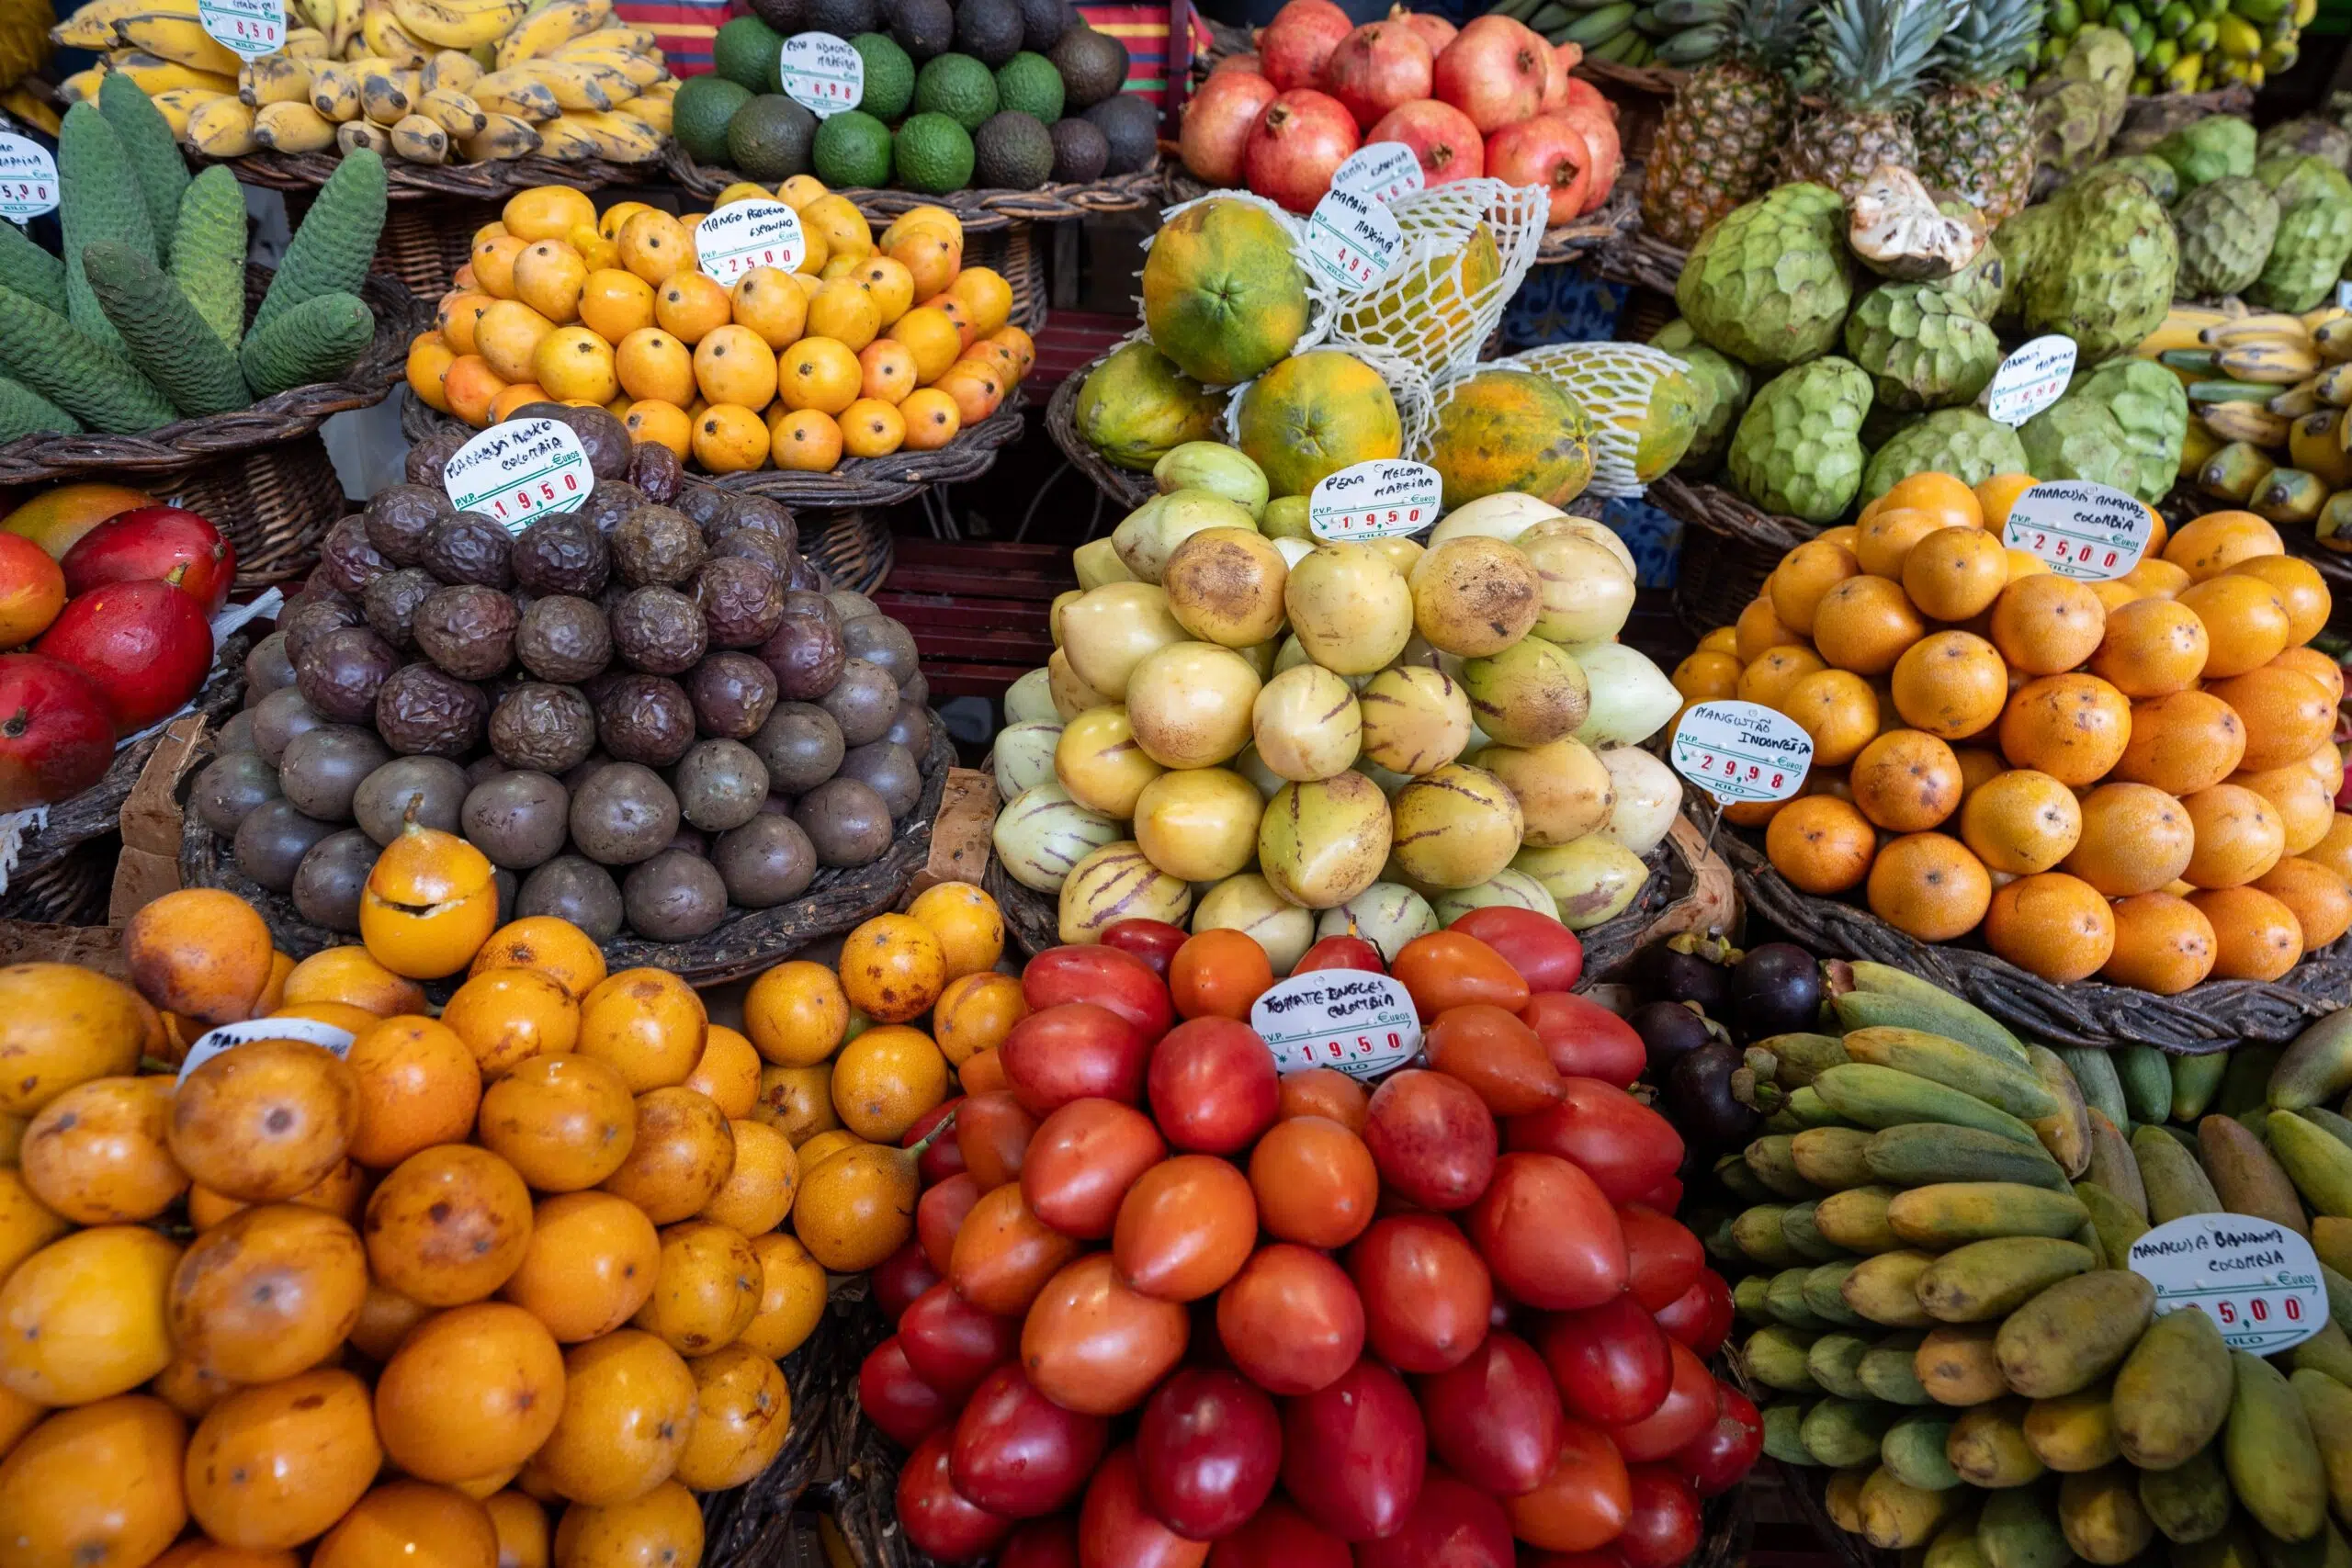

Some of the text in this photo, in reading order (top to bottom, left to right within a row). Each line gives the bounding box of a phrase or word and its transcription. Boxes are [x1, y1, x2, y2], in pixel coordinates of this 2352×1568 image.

[702, 211, 743, 232] MANGO
[455, 492, 478, 508] P.V.P.
[1313, 506, 1332, 515] P.V.P.
[1678, 732, 1699, 744] P.V.P.
[1714, 781, 1746, 795] KILO
